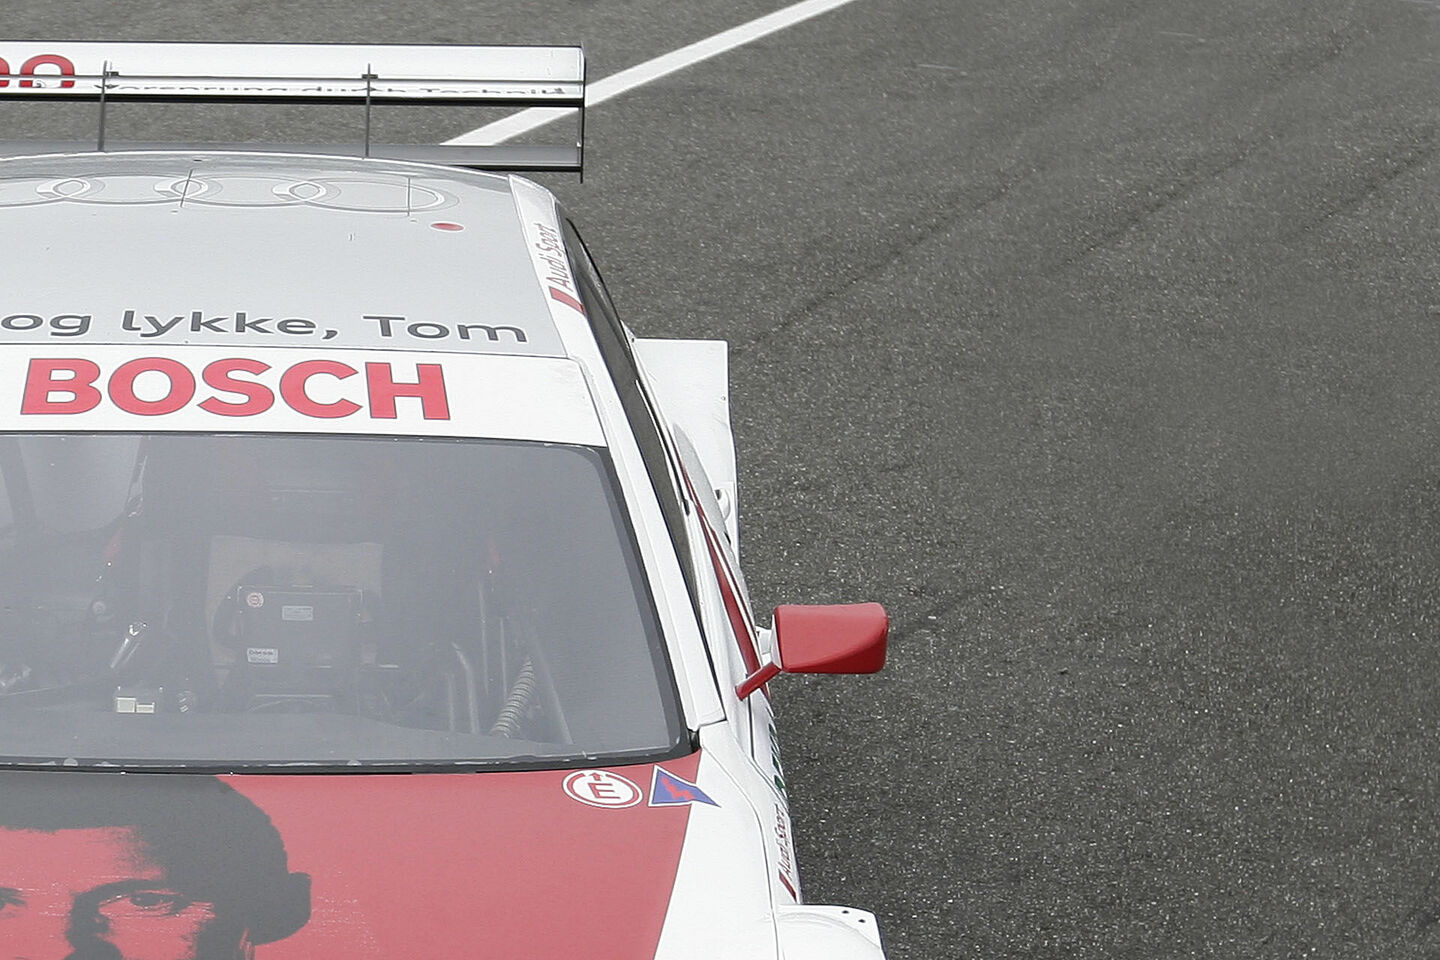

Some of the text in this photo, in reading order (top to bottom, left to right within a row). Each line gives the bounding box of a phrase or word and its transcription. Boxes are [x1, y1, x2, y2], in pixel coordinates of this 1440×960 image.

[533, 222, 574, 292] Audi Sport
[1, 314, 92, 337] og
[122, 310, 338, 340] lykke,
[362, 315, 528, 343] Tom
[20, 357, 450, 421] BOSCH
[588, 782, 621, 799] E
